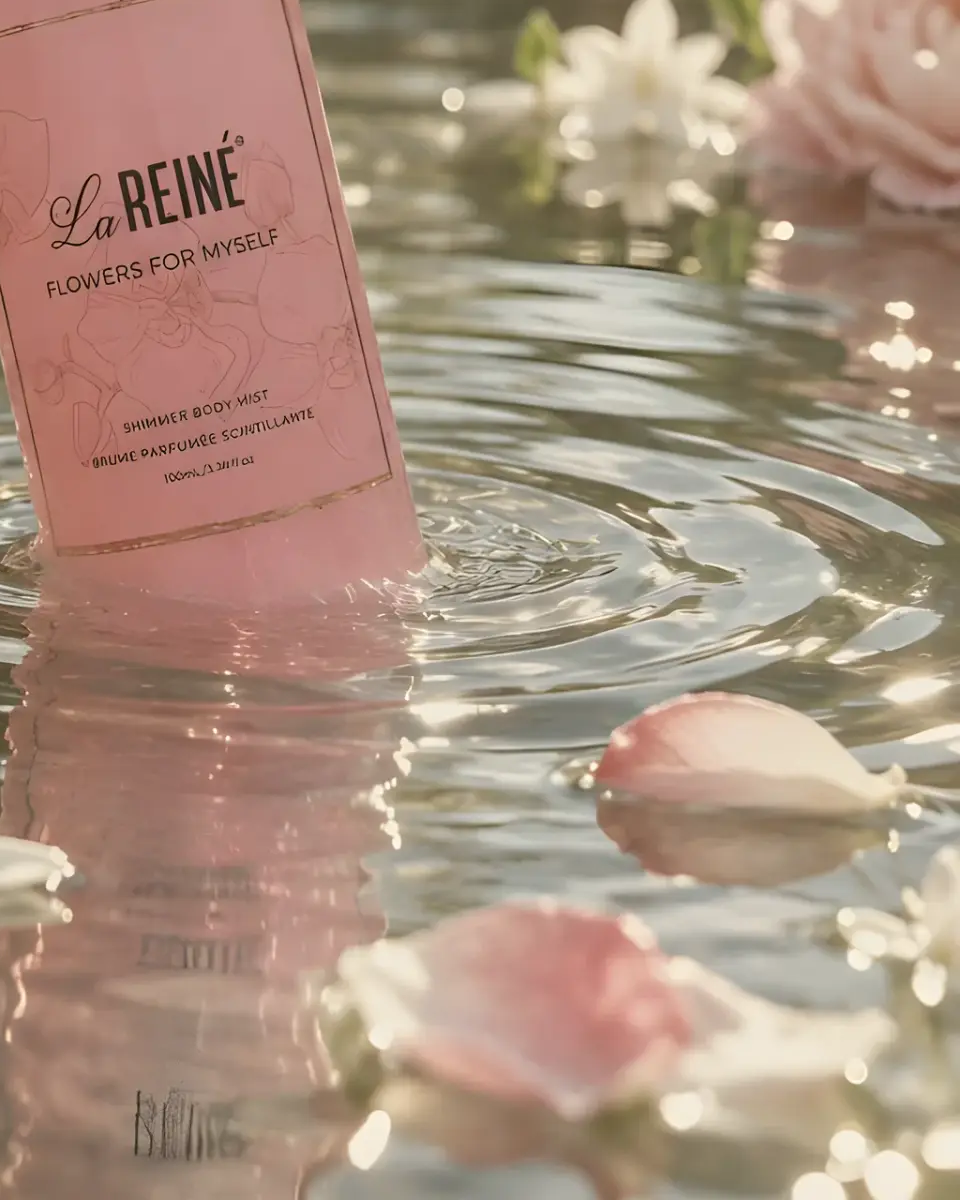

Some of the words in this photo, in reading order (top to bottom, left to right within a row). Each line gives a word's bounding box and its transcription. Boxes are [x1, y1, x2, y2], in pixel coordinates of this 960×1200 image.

[50, 173, 122, 250] La
[46, 261, 144, 299] FLOWERS
[149, 248, 196, 276] FOR
[202, 228, 279, 262] MYSELF
[192, 399, 232, 418] BODY
